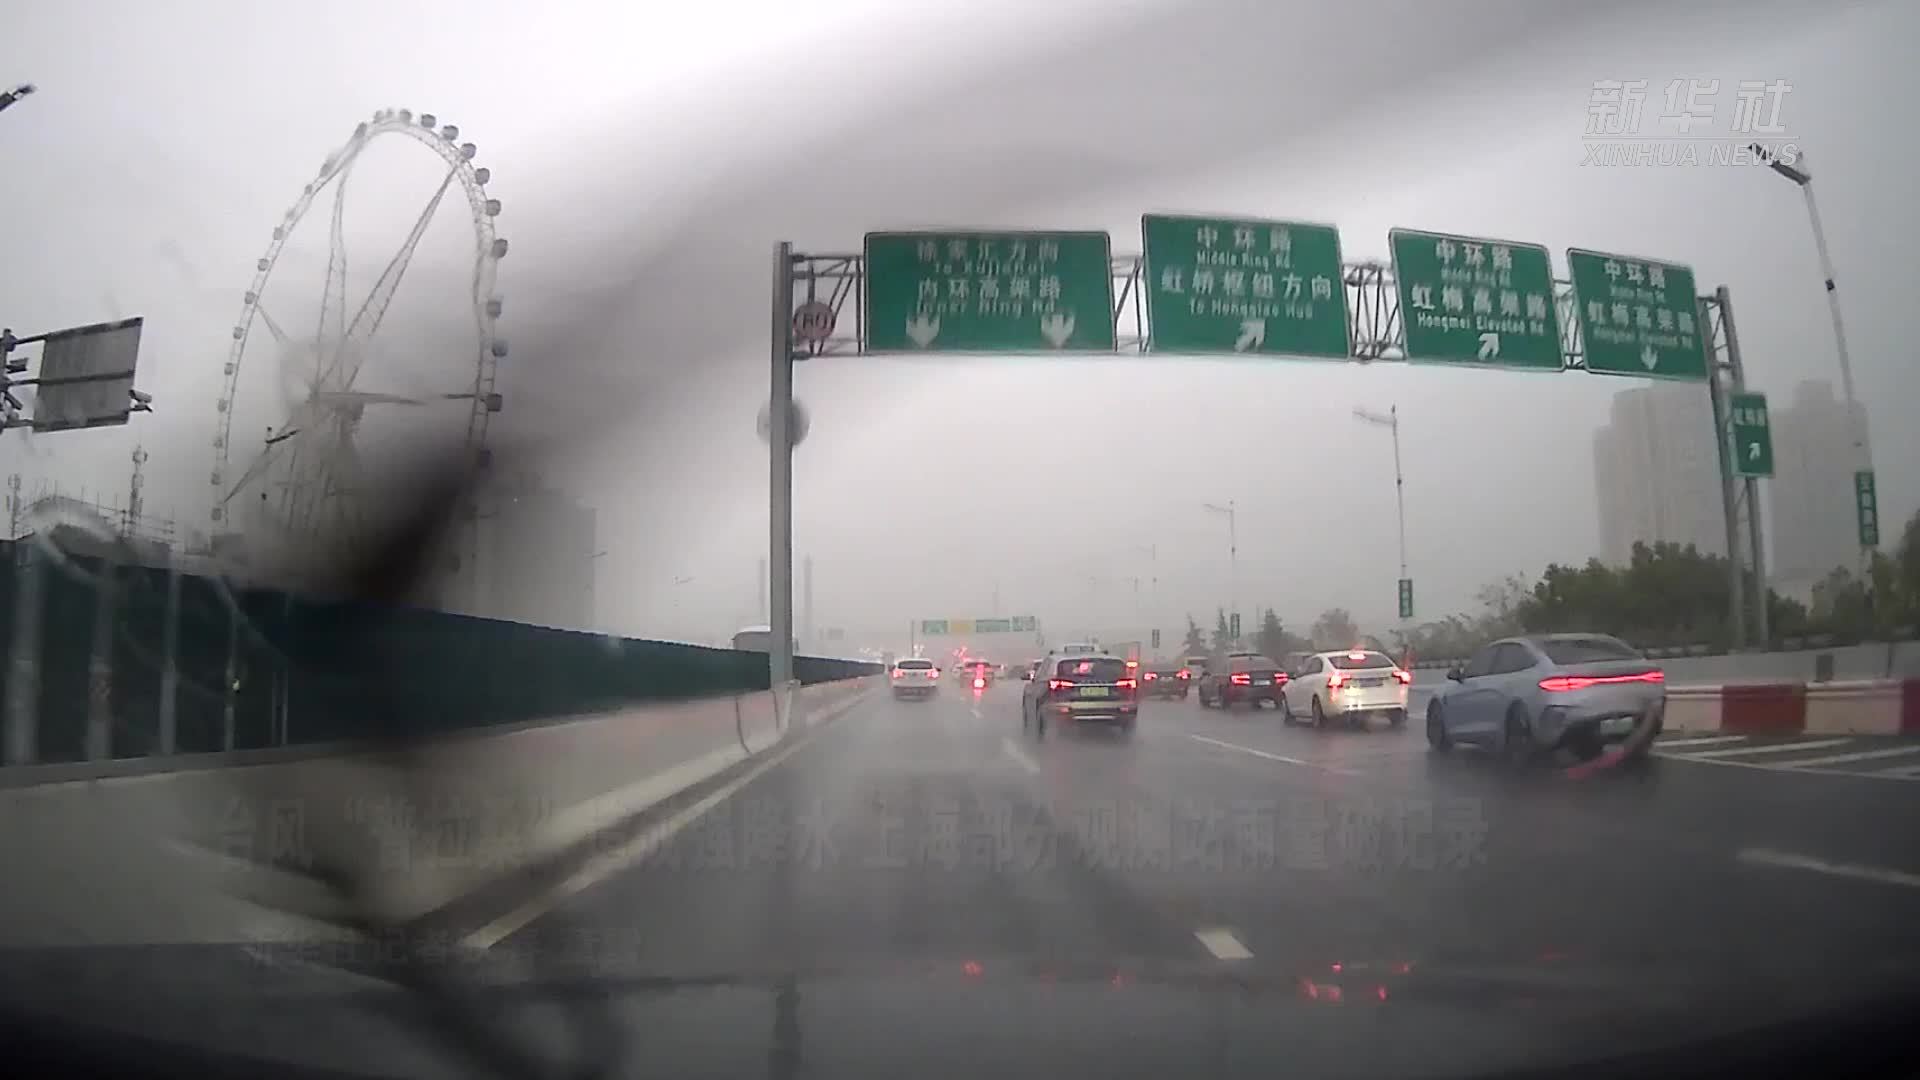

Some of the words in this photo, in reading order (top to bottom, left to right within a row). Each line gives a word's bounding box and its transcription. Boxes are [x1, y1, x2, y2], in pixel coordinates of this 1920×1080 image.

[1197, 224, 1291, 251] 中环路
[1436, 239, 1512, 270] 中环路
